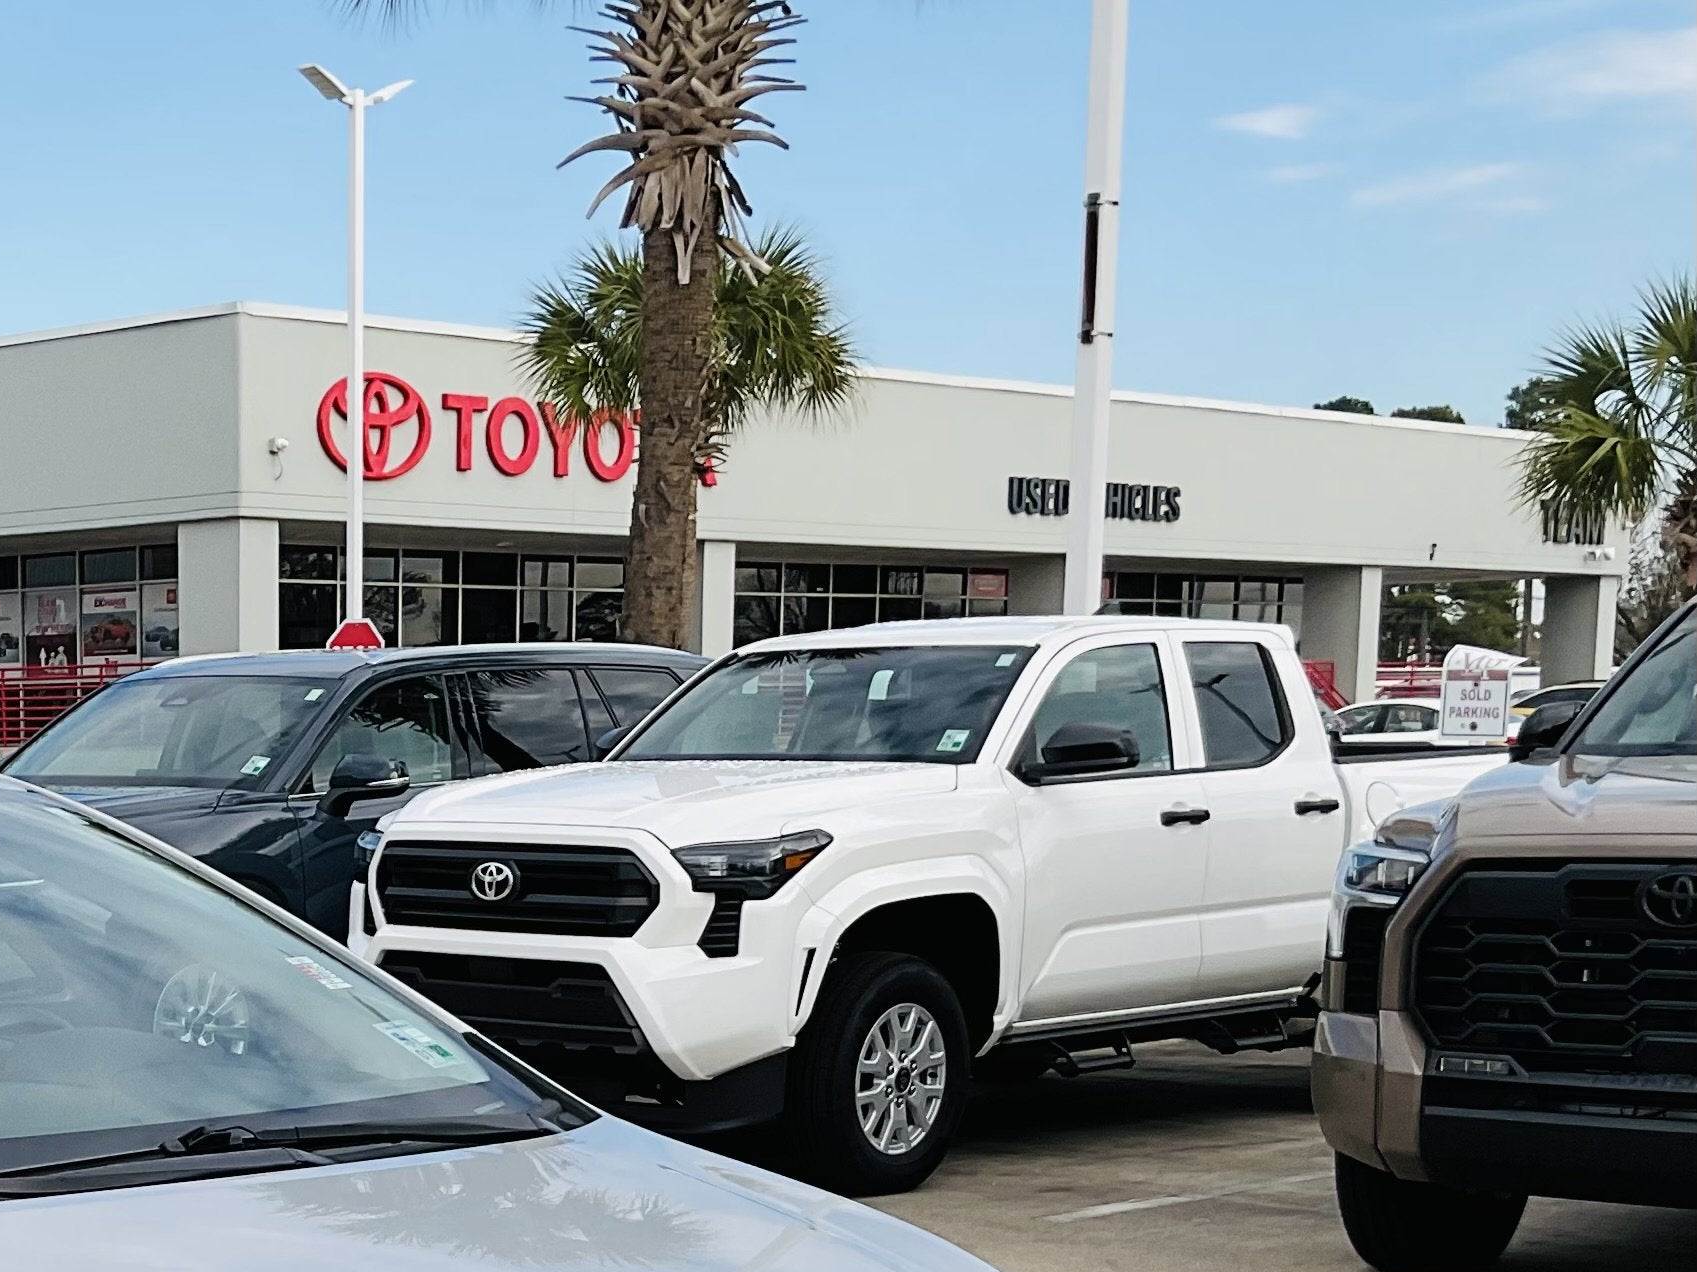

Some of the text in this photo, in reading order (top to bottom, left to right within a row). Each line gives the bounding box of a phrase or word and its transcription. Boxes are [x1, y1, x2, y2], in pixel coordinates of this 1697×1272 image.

[442, 393, 717, 487] TOYO
[1008, 476, 1182, 523] USED HICLES
[1460, 688, 1492, 701] SOLD
[1448, 706, 1500, 719] PARKING
